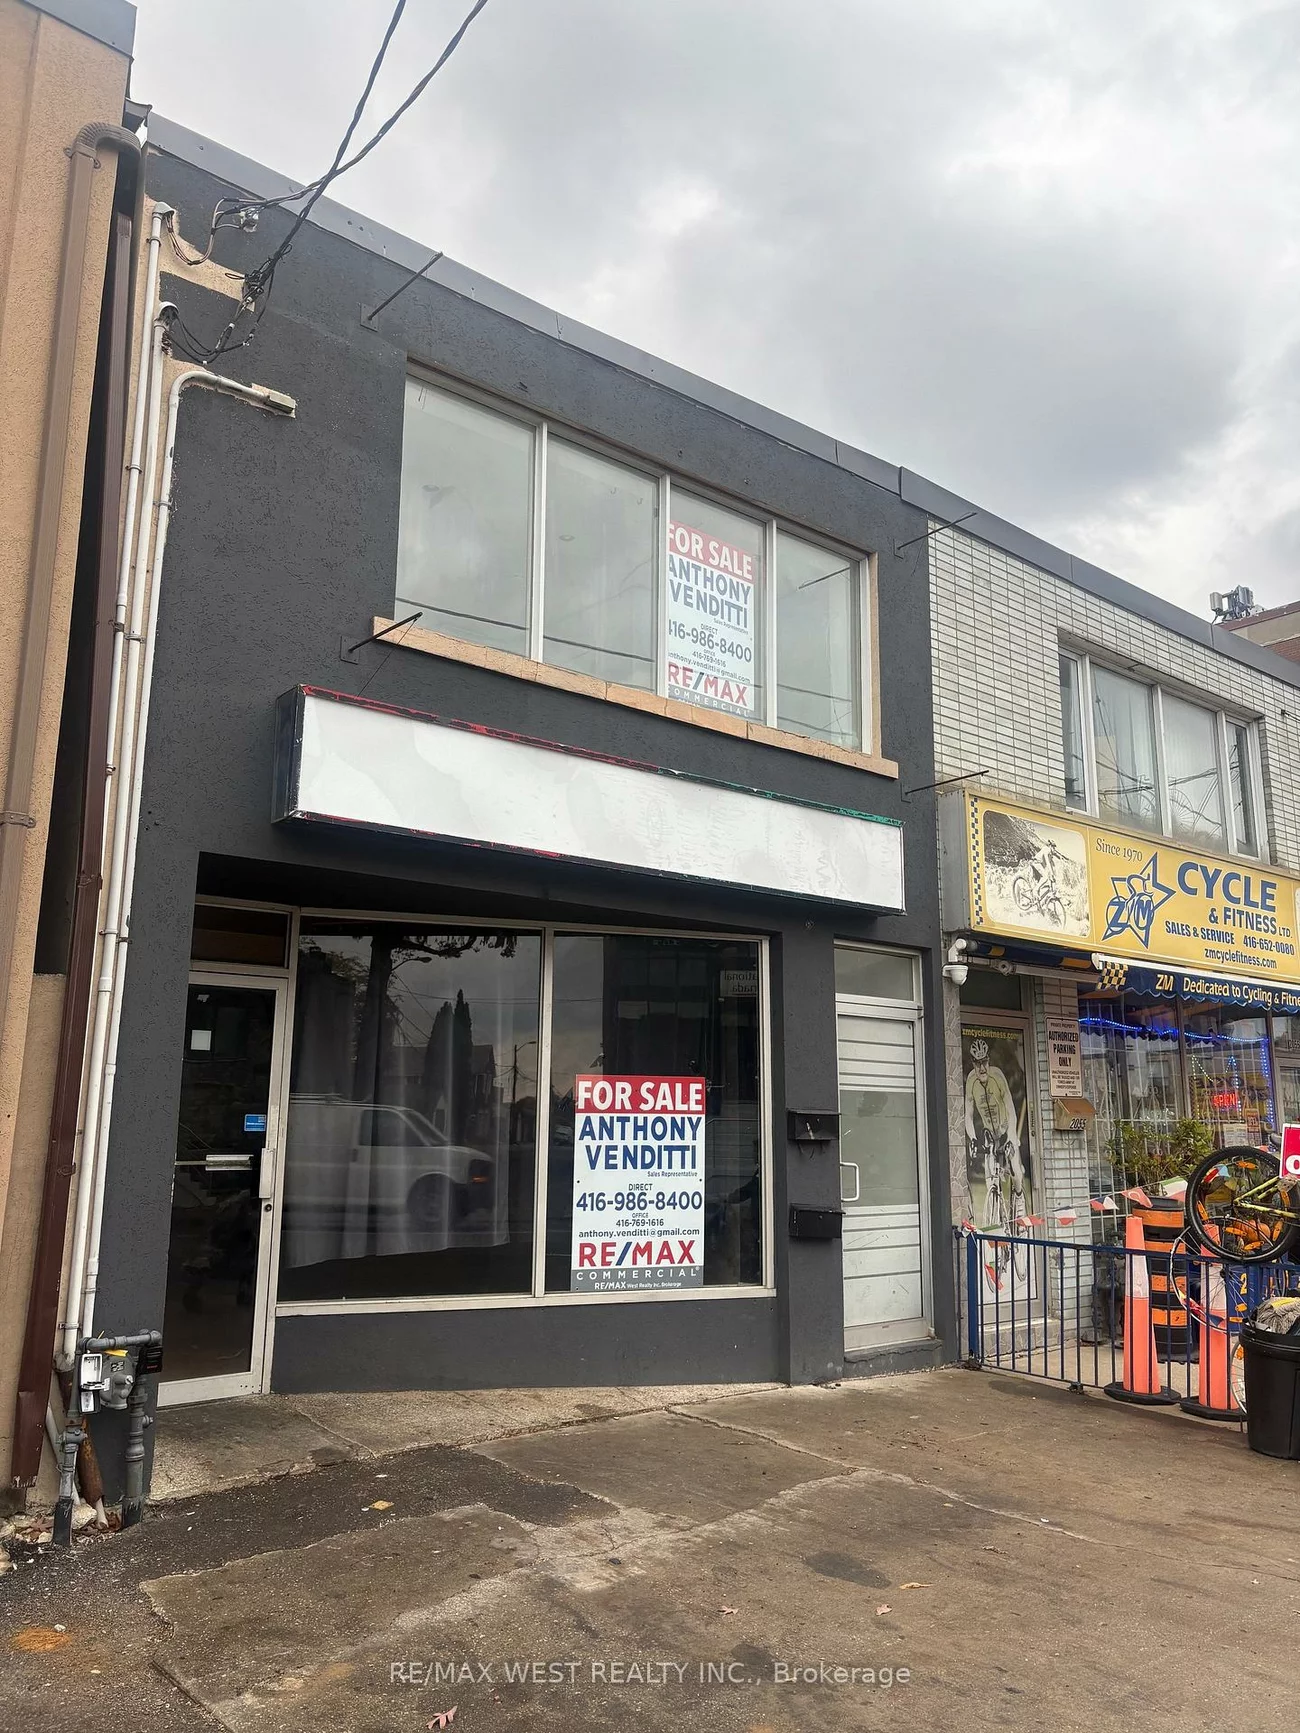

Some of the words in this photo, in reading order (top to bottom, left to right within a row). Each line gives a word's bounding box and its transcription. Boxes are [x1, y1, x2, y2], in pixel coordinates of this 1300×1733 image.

[708, 540, 752, 580] SALE
[669, 554, 751, 605] ANTHONY
[670, 579, 748, 629] VENDITTI
[700, 623, 718, 635] DIRECT
[668, 661, 748, 707] RE/MAX
[1095, 837, 1121, 857] Since
[1123, 847, 1143, 862] 1970
[1177, 861, 1277, 913] CYCLE
[1208, 907, 1219, 925] &
[1223, 906, 1277, 936] FITNESS
[1164, 920, 1191, 937] SALES
[1192, 926, 1199, 938] &
[1200, 927, 1235, 946] SERVICE
[1243, 934, 1295, 956] 416-652-0080
[1204, 947, 1278, 970] zmcyclefitness.com
[1155, 974, 1174, 991] ZM
[1183, 977, 1230, 997] Dedicated
[1231, 983, 1241, 998] to
[1242, 985, 1272, 1006] Cycling
[1273, 993, 1280, 1004] &
[1048, 1030, 1079, 1042] AUTHORIZED
[1053, 1043, 1076, 1055] PARKING
[1058, 1056, 1072, 1067] ONLY
[577, 1080, 632, 1110] FOR
[639, 1081, 703, 1111] SALE
[578, 1115, 702, 1141] ANTHONY
[585, 1144, 697, 1171] VENDITTI
[647, 1170, 661, 1178] Sales
[661, 1170, 698, 1178] Representative
[628, 1183, 653, 1192] DIRECT
[576, 1191, 703, 1212] 416-986-8400
[578, 1228, 701, 1239] anthony.venditti@gmail.com
[616, 1218, 665, 1228] 416-769-1616
[578, 1240, 696, 1268] RE/MAX
[576, 1268, 697, 1281] COMMERCIAL
[594, 1281, 627, 1291] RE/MAX
